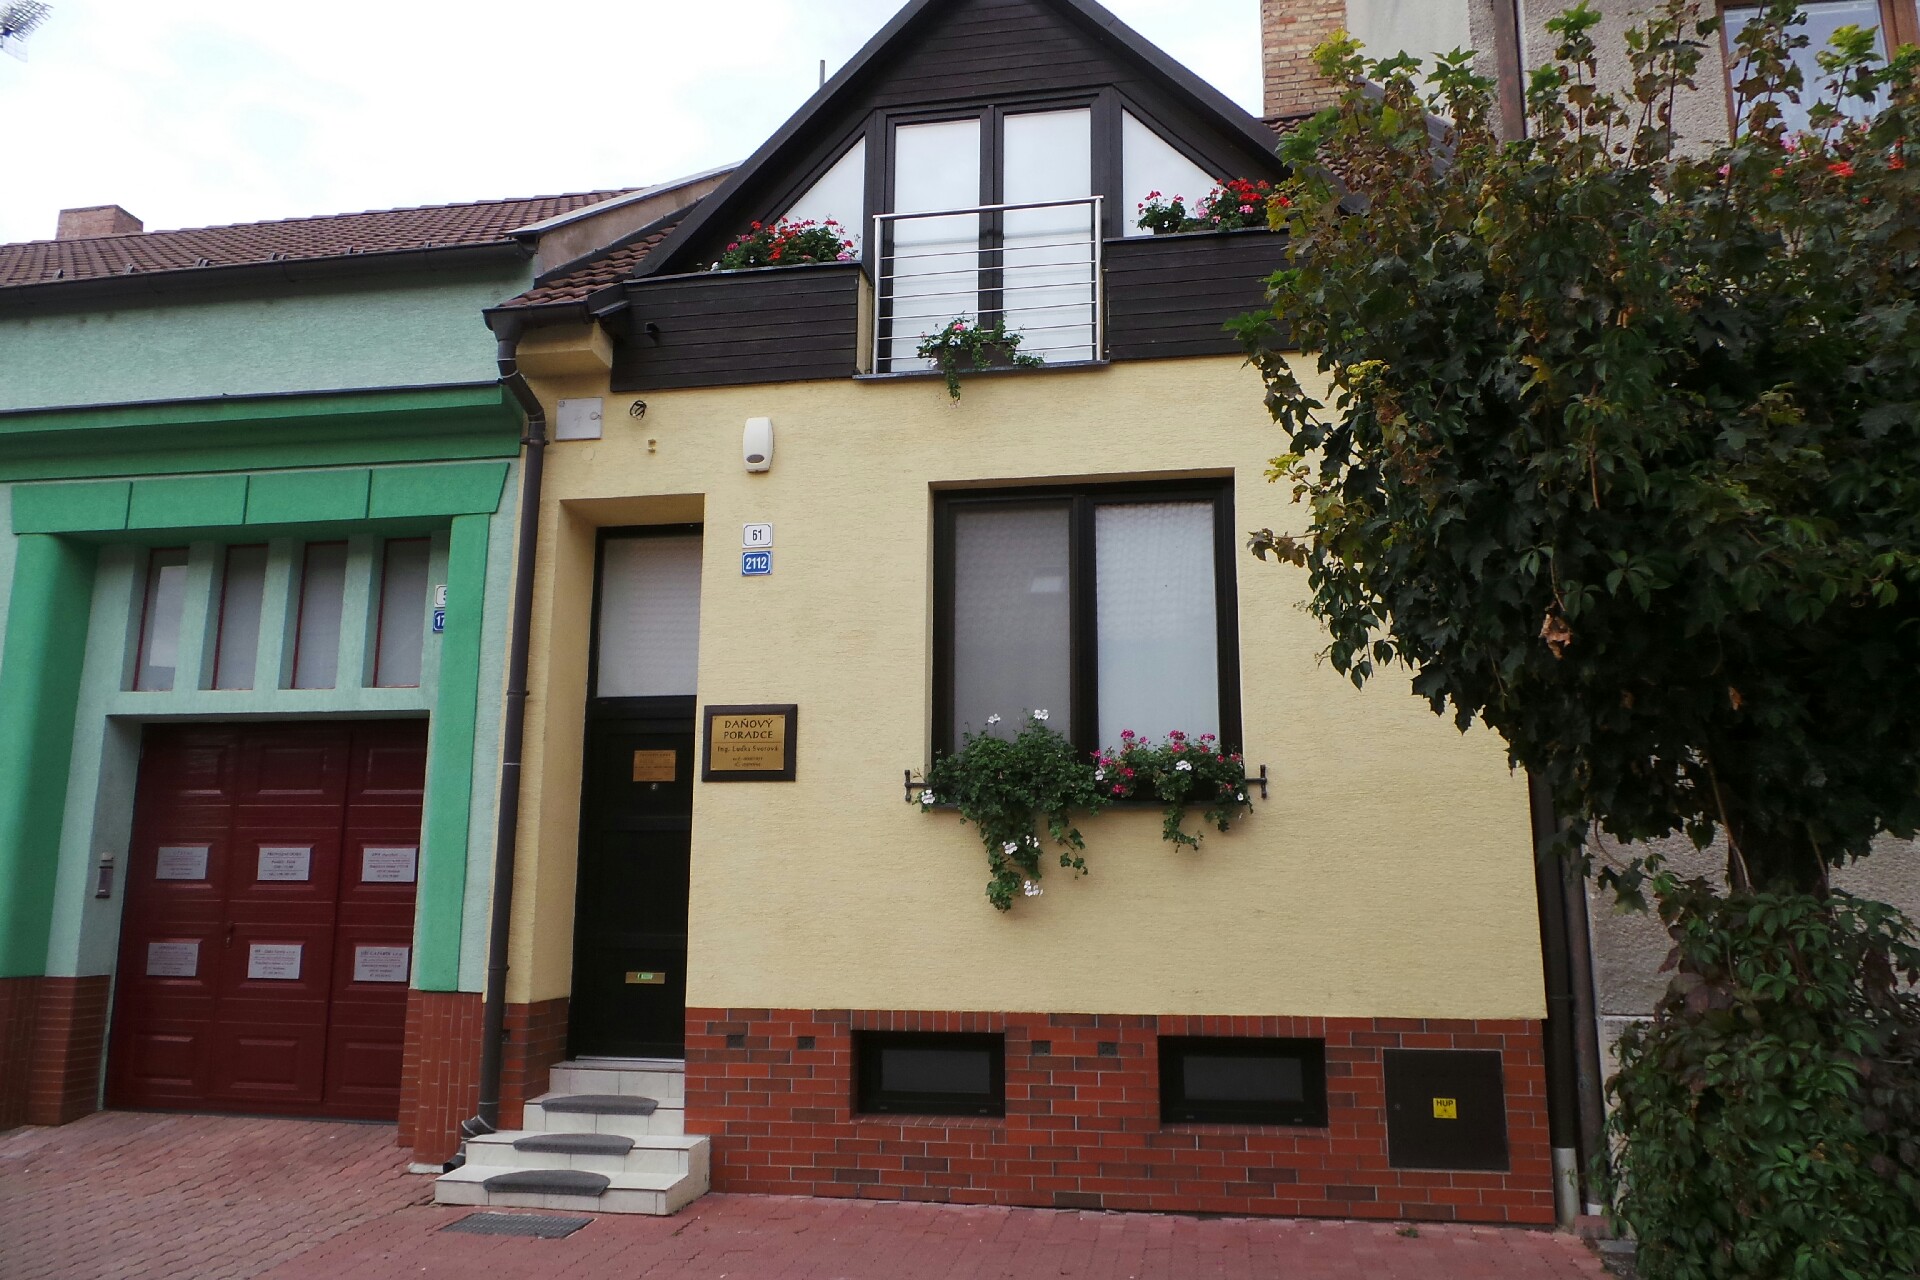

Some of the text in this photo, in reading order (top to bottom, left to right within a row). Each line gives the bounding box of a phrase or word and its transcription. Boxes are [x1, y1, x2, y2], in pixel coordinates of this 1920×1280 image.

[752, 529, 762, 541] 61
[745, 556, 767, 570] 2112
[724, 718, 774, 729] DAŇOVÝ
[724, 730, 773, 739] PORADCE
[717, 746, 730, 754] Ing.
